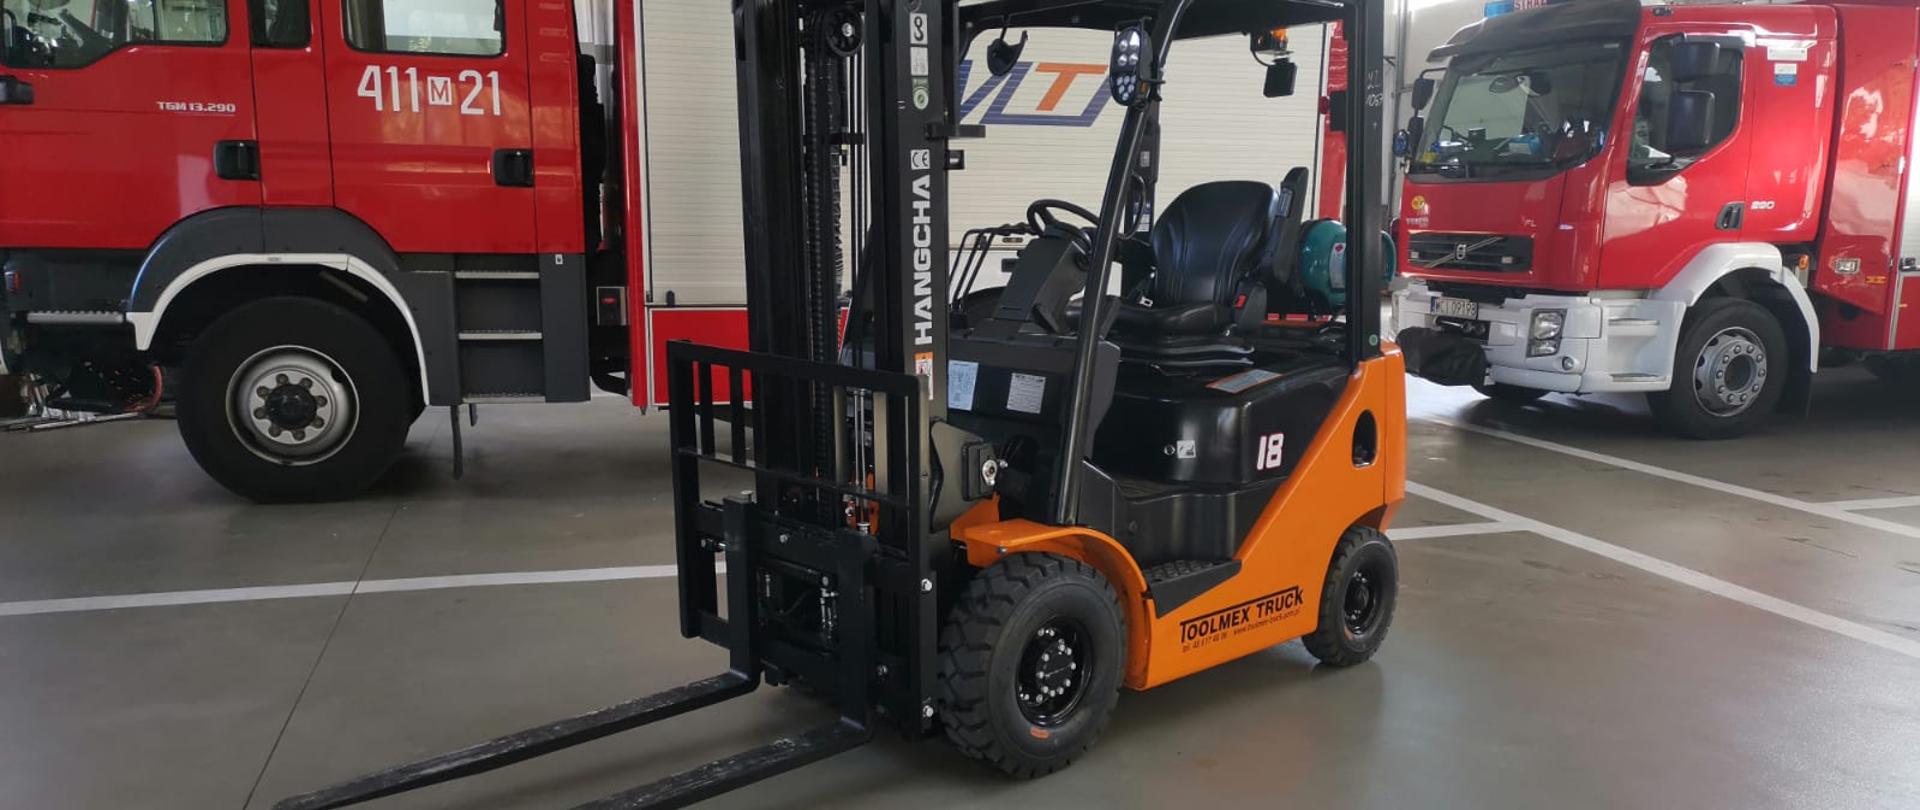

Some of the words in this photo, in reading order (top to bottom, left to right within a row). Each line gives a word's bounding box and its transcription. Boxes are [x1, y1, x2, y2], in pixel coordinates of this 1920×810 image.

[156, 101, 187, 111] TGM
[188, 103, 236, 112] 13.290
[357, 65, 419, 112] 411
[427, 76, 453, 105] M
[458, 69, 501, 116] 21
[911, 151, 929, 169] CE
[912, 174, 933, 346] HANGCHA
[1257, 433, 1284, 470] 18
[1179, 606, 1251, 643] TOOLMEX
[1256, 586, 1303, 618] TRUCK
